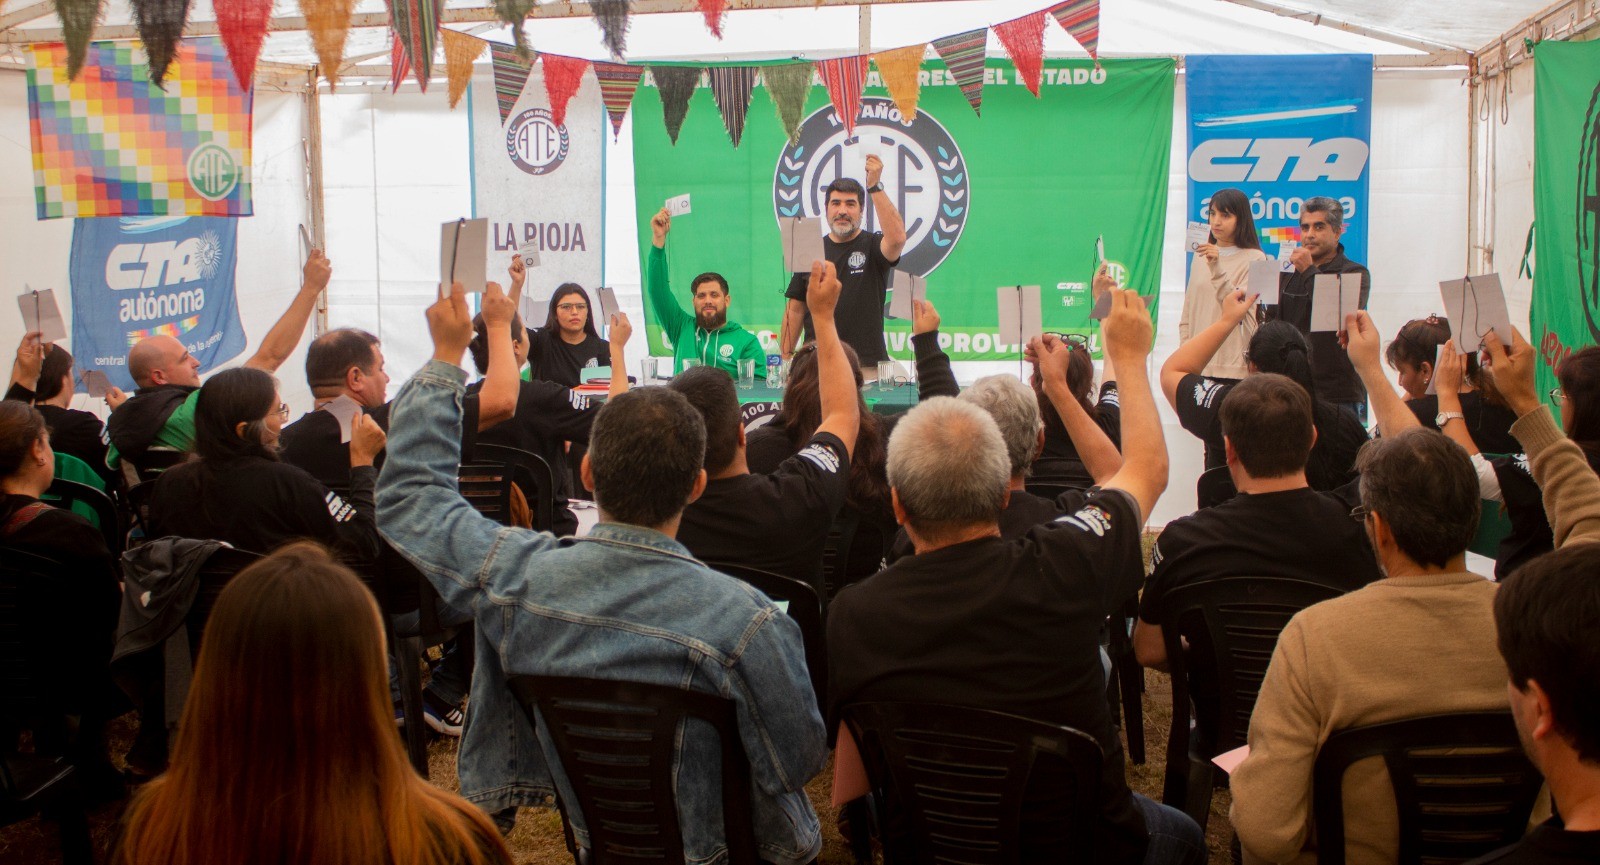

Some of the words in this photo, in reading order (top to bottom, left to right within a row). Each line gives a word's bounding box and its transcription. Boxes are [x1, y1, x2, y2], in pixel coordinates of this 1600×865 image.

[983, 68, 1008, 85] EL
[1015, 68, 1107, 86] ETADO
[518, 121, 555, 161] ATE
[193, 149, 231, 194] ATE
[1188, 137, 1369, 183] CTA
[1200, 191, 1356, 220] aónoa
[494, 222, 518, 251] LA
[105, 237, 203, 290] CTA
[119, 288, 205, 323] autónoma
[95, 355, 126, 366] central
[742, 403, 765, 420] 100
